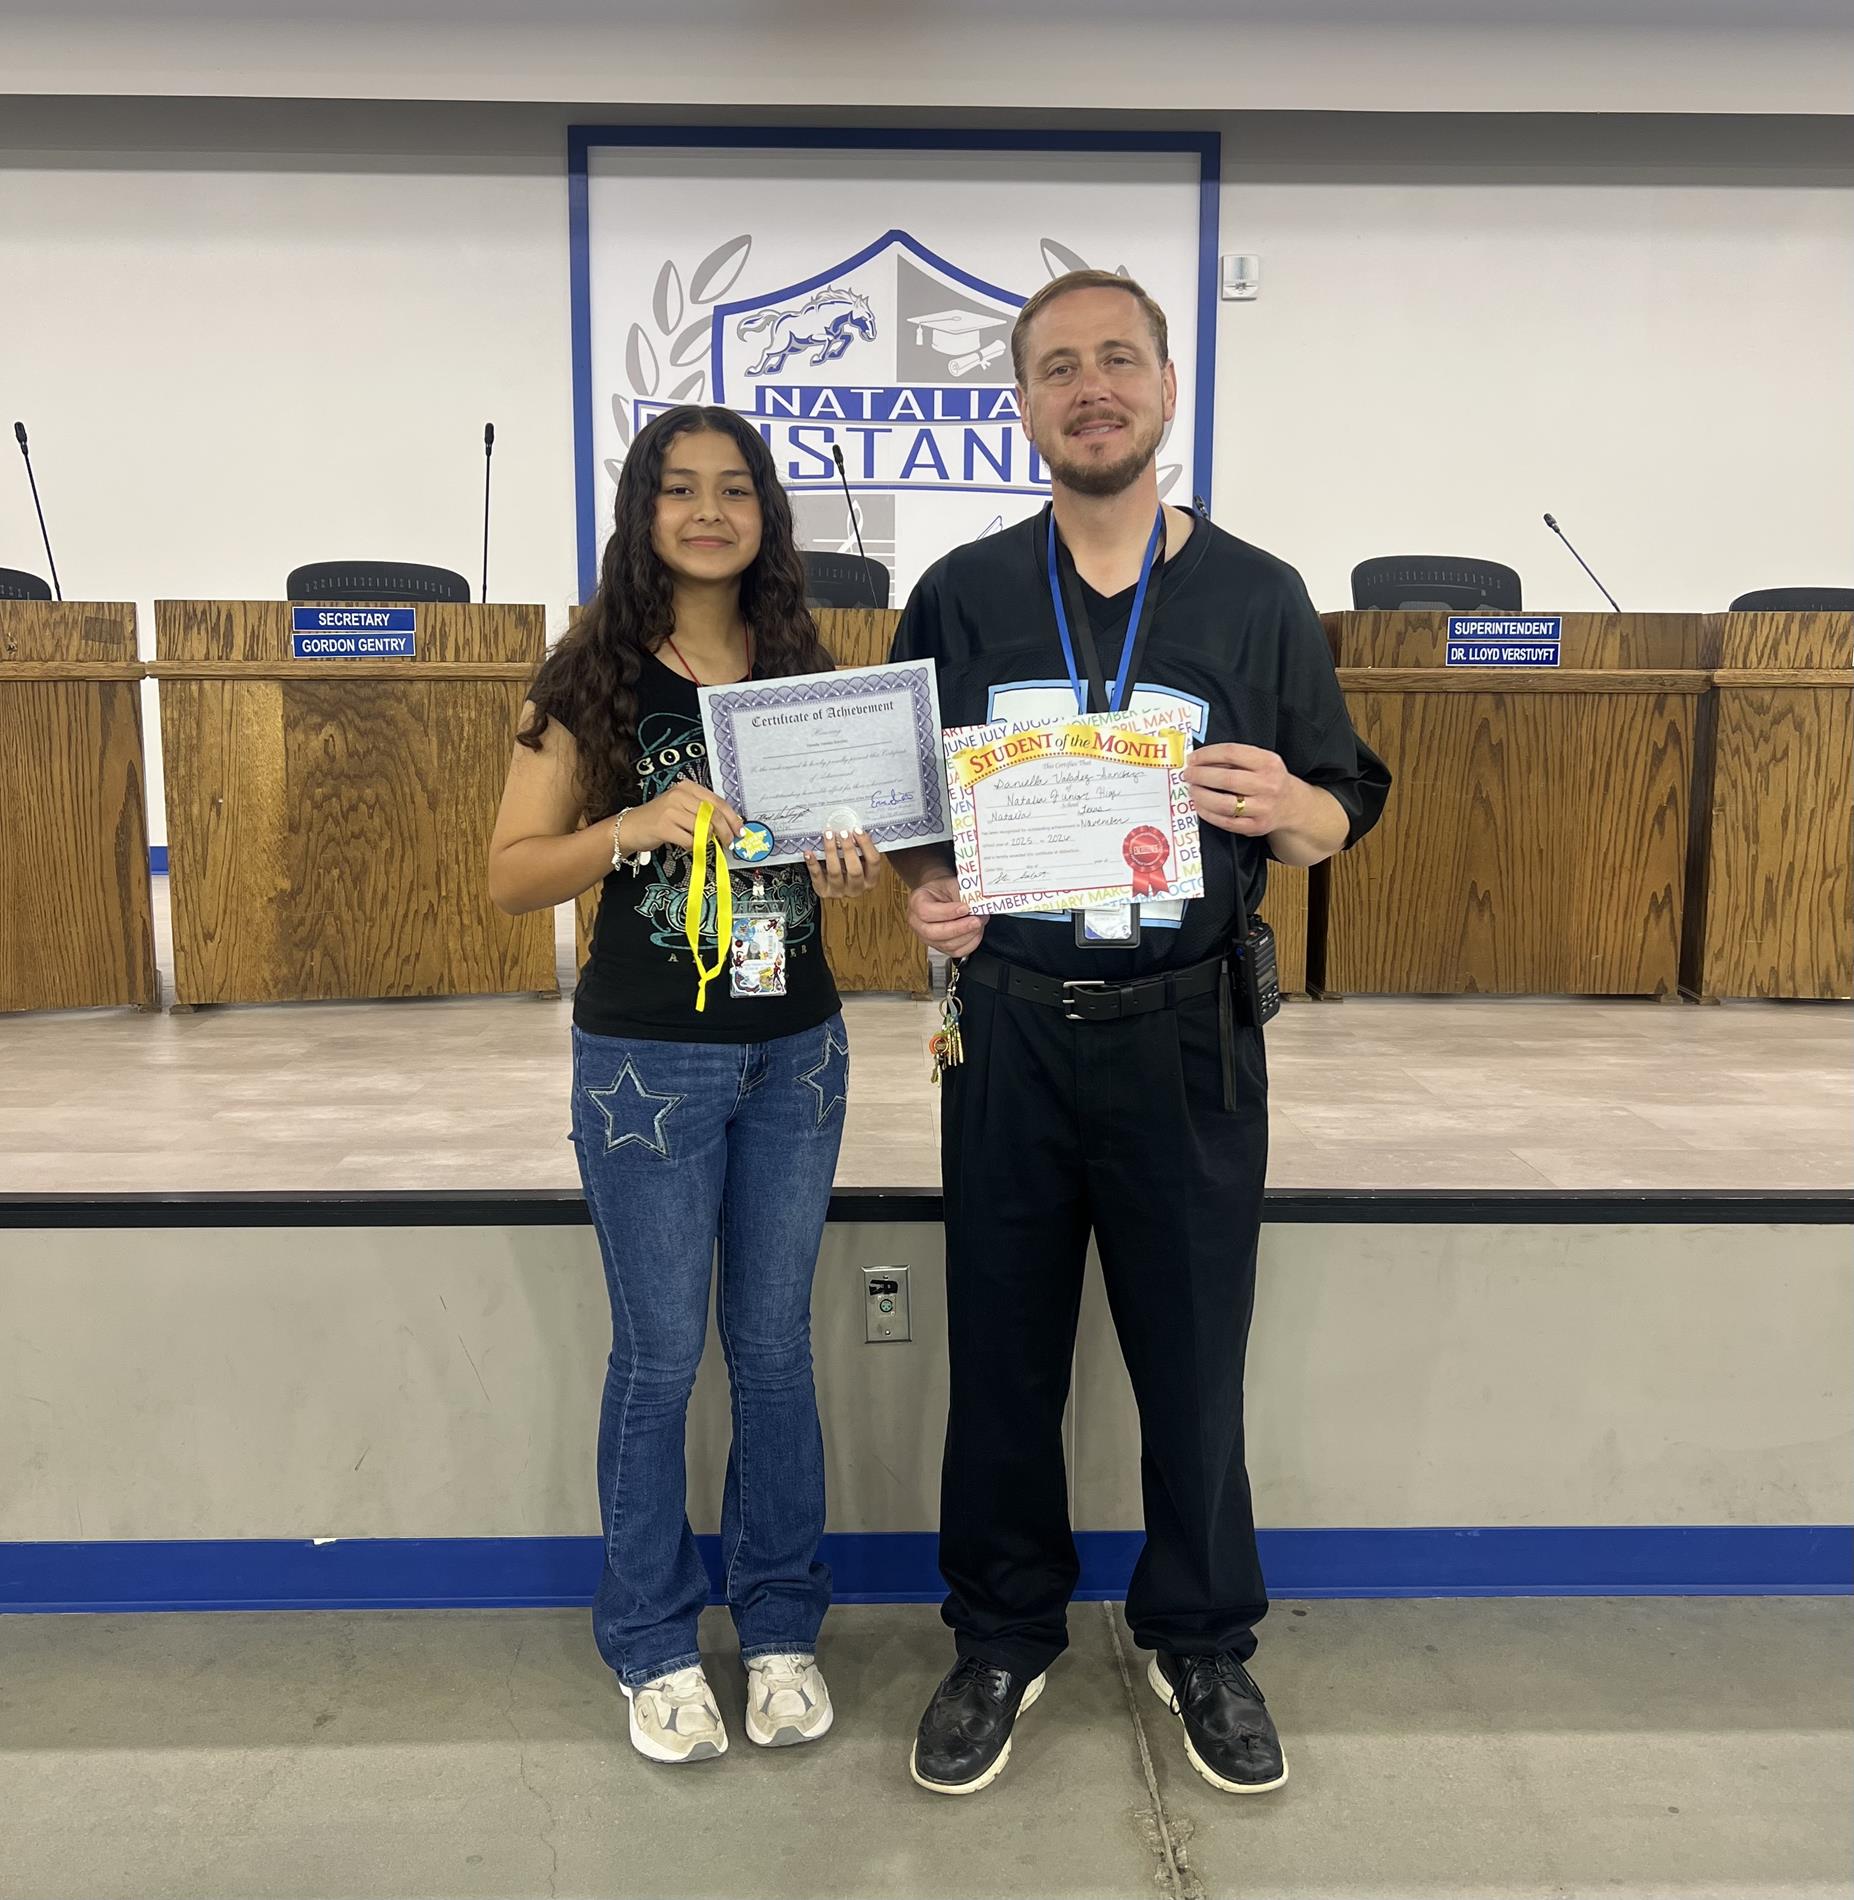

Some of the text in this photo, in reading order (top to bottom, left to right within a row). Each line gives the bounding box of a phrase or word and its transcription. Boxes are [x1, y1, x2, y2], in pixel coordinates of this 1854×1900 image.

[765, 387, 1021, 420] NATALIA
[318, 612, 390, 626] SECRETARY
[1455, 622, 1554, 635] SUPERINTENDENT
[302, 638, 406, 652] GORDON GENTRY
[1451, 648, 1555, 661] DR. LLOYD VERSTUYFT
[751, 701, 894, 728] Certificate of Achievement
[1144, 710, 1173, 729] MAY
[944, 734, 977, 756] JUNE
[980, 725, 1007, 746] JULY
[969, 733, 1053, 774] STUDENT
[1055, 733, 1070, 751] of
[1071, 734, 1090, 748] the
[1092, 731, 1167, 759] MONTH
